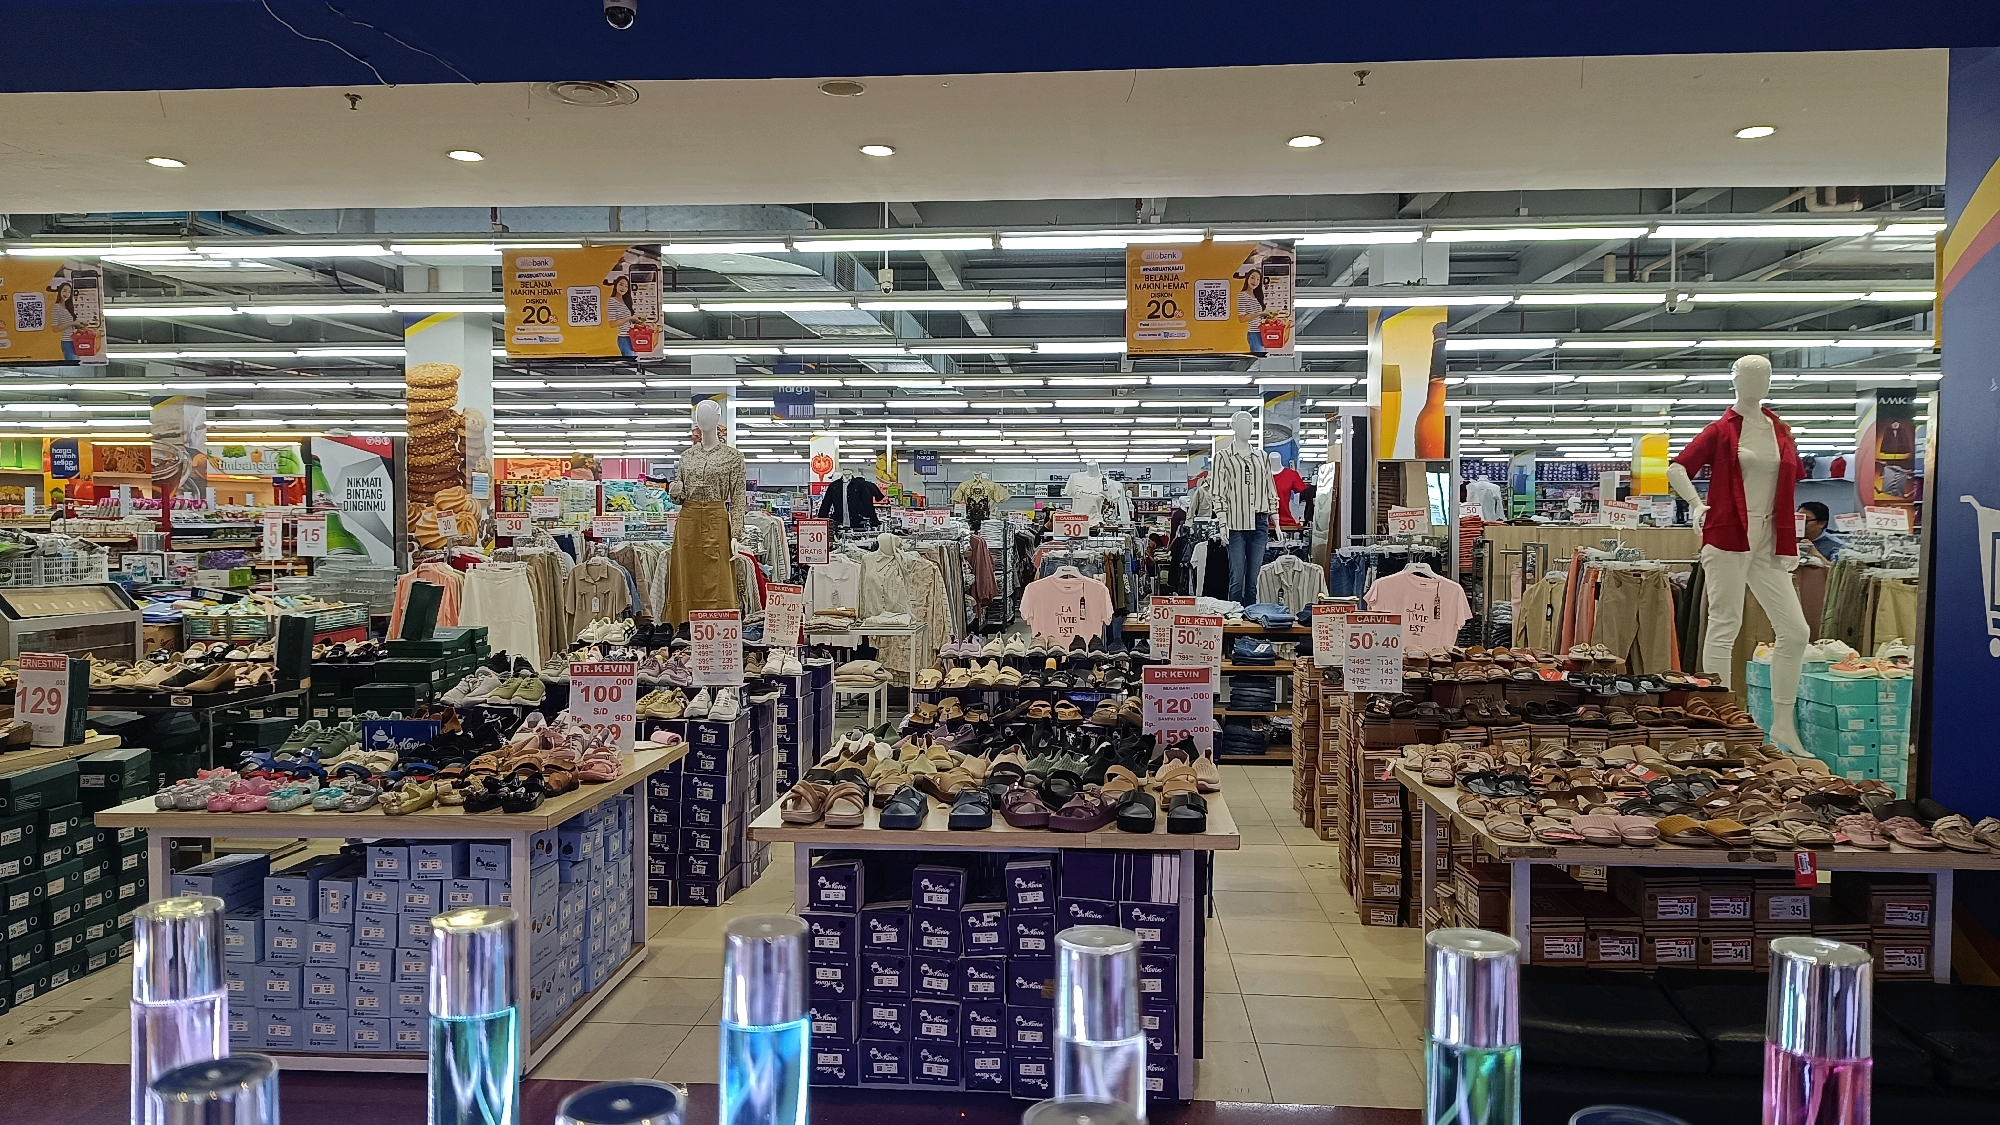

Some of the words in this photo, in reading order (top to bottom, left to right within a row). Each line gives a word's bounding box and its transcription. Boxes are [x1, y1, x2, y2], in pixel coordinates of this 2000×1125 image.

[218, 460, 279, 473] timbangan
[347, 478, 381, 487] NIKMATI
[346, 489, 382, 499] BINTANG
[344, 500, 386, 511] DINGINMU
[1607, 511, 1626, 522] 195
[1876, 518, 1898, 526] 279
[270, 522, 277, 546] 5
[302, 529, 320, 541] 15
[1414, 603, 1425, 611] LA
[1415, 614, 1428, 623] VIE
[21, 658, 66, 669] ERNESTINE
[574, 665, 630, 673] DR.KEVIN
[581, 686, 622, 702] 100
[16, 687, 62, 715] 129
[1154, 699, 1192, 713] 120
[1387, 797, 1394, 805] 34
[1384, 824, 1392, 832] 35
[1678, 904, 1689, 915] 35
[1730, 904, 1742, 914] 35
[1790, 905, 1802, 916] 35
[1907, 912, 1920, 922] 35
[1565, 944, 1576, 954] 33
[1620, 945, 1631, 956] 34
[1677, 948, 1687, 958] 31
[1733, 949, 1744, 958] 34
[1906, 956, 1917, 966] 33
